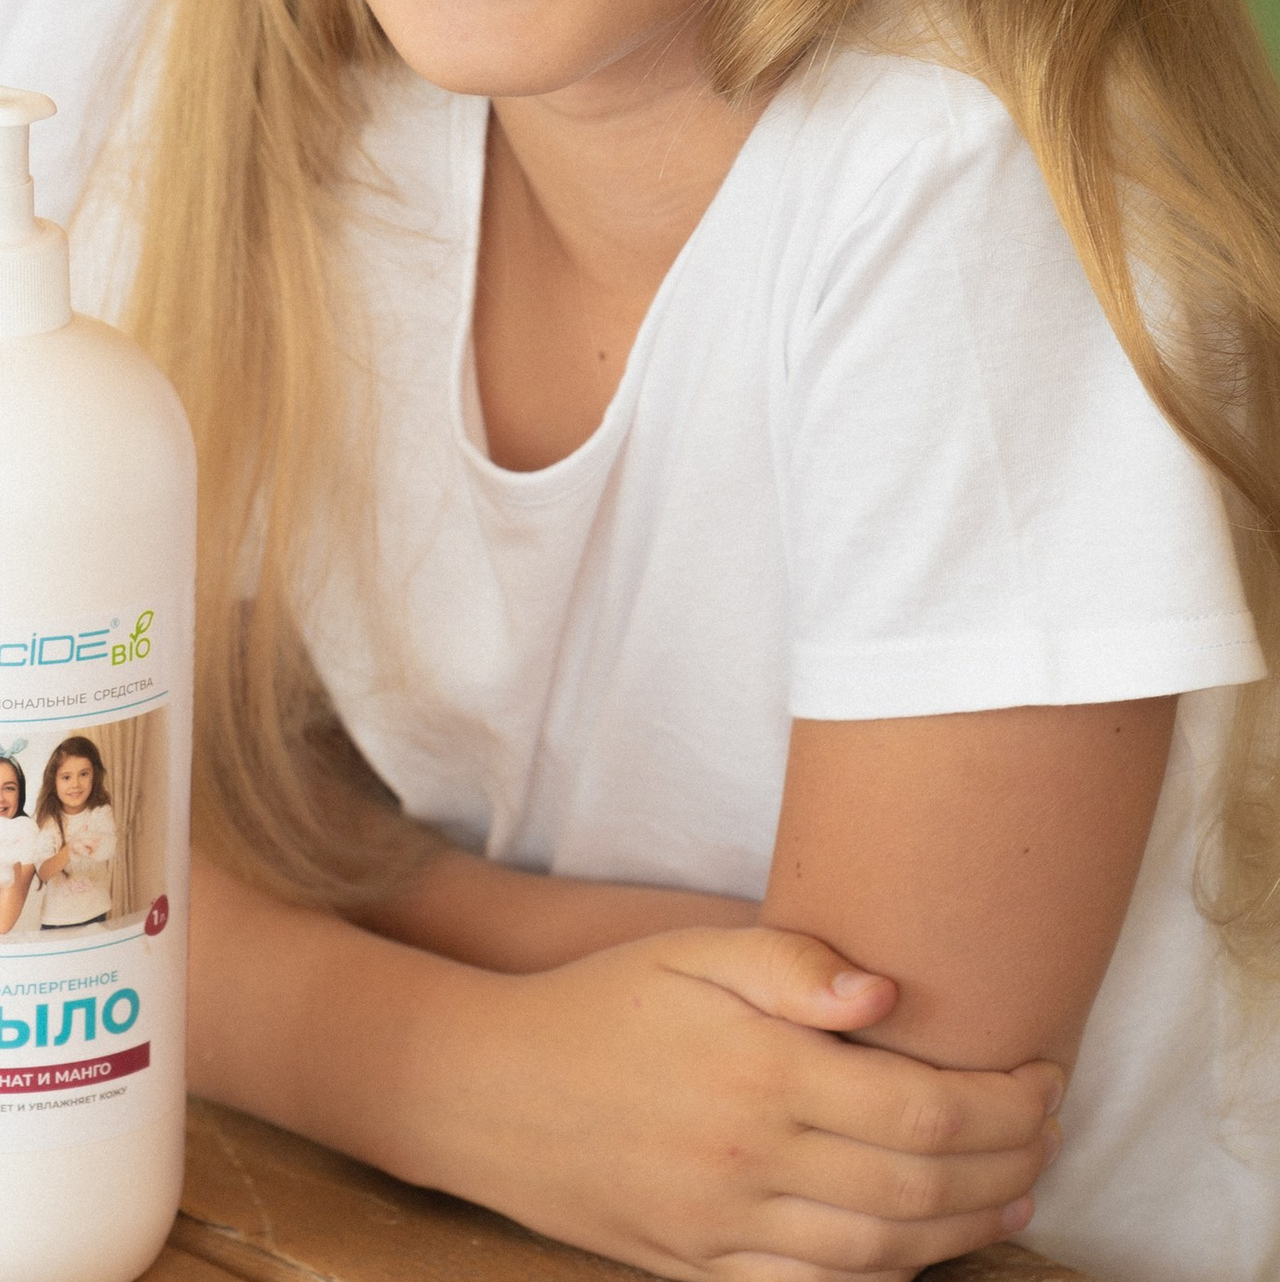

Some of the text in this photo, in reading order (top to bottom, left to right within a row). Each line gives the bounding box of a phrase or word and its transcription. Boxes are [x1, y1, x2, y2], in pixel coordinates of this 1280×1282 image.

[93, 676, 154, 701] СРЕДСТВА
[37, 1071, 51, 1086] И
[54, 1062, 113, 1084] МАНГО
[17, 1103, 26, 1113] И
[28, 1094, 97, 1112] УВЛАЖНЯЕТ
[99, 1086, 128, 1102] КОЖУ
